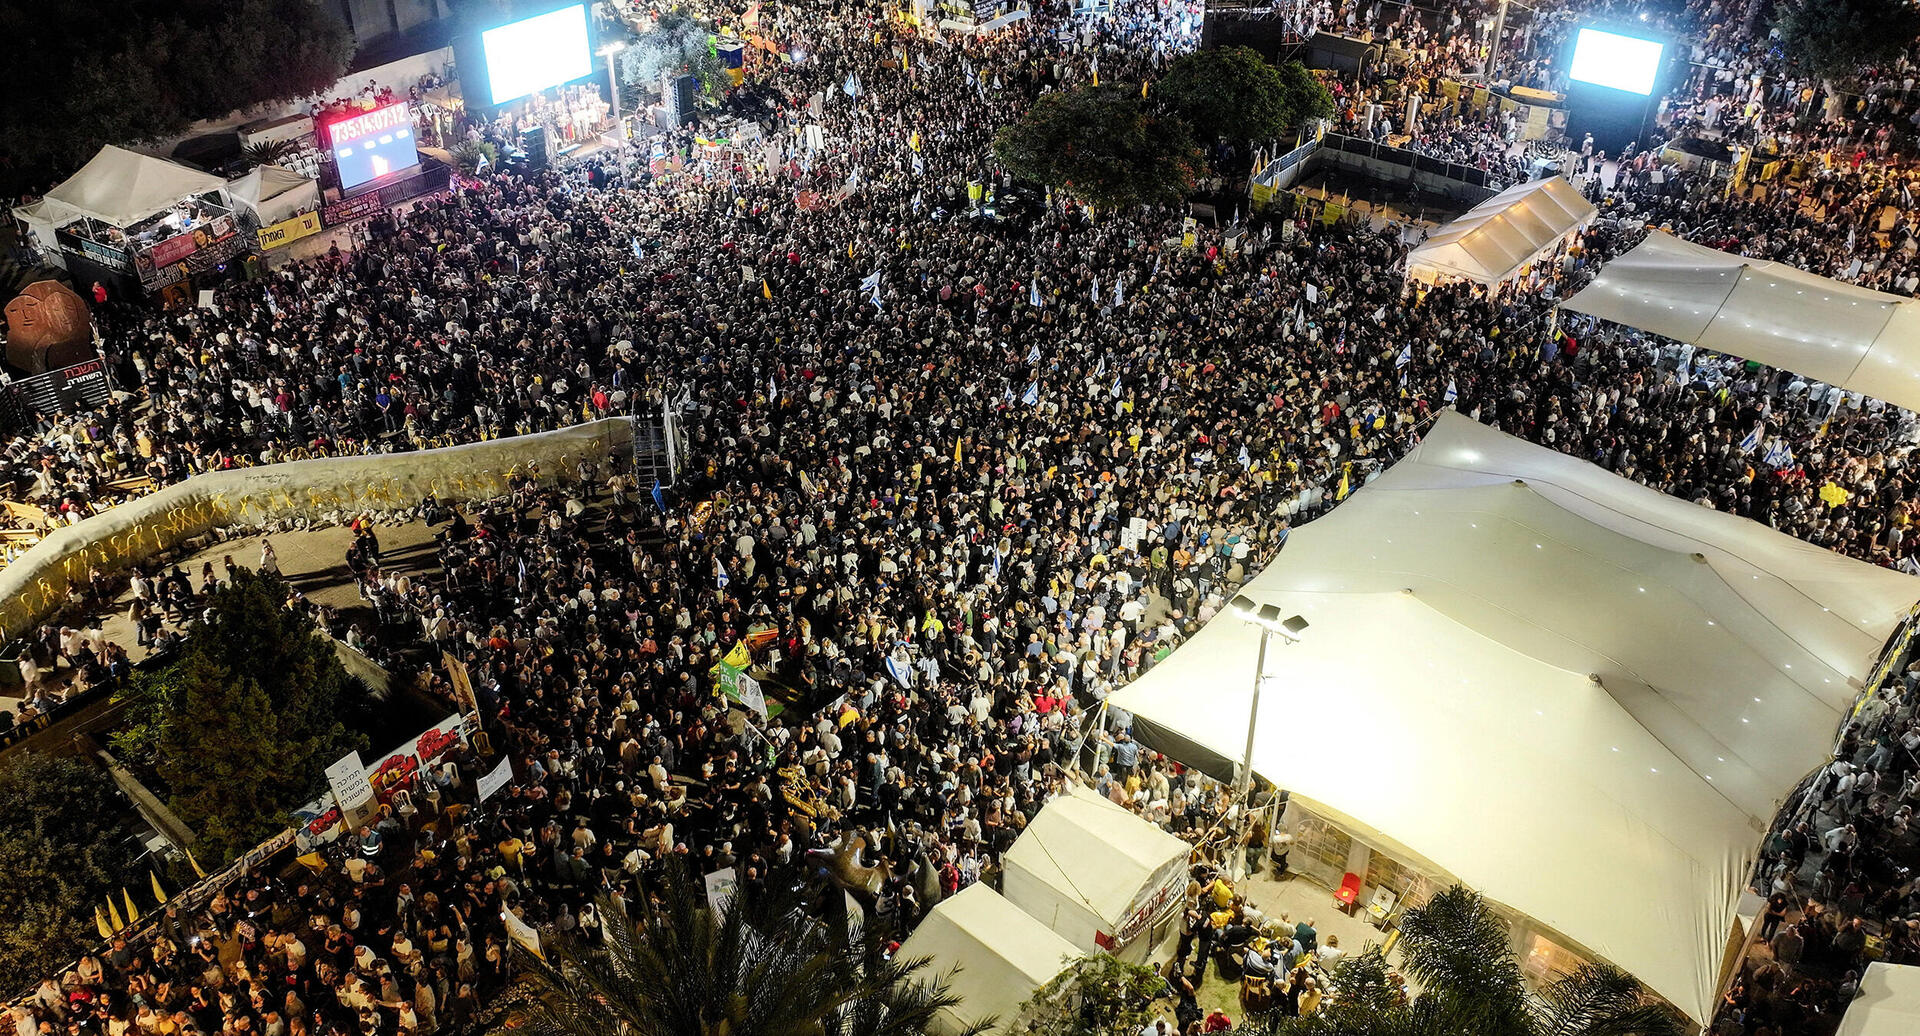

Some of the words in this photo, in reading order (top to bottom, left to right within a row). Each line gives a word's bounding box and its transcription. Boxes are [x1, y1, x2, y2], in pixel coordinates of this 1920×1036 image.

[332, 105, 406, 143] 735:14:07:12
[260, 229, 285, 246] האחרון
[64, 361, 101, 379] השבת
[67, 371, 103, 386] השחורה
[336, 769, 361, 788] תמיכה
[340, 778, 364, 796] נפשית
[340, 784, 370, 806] ראשונית
